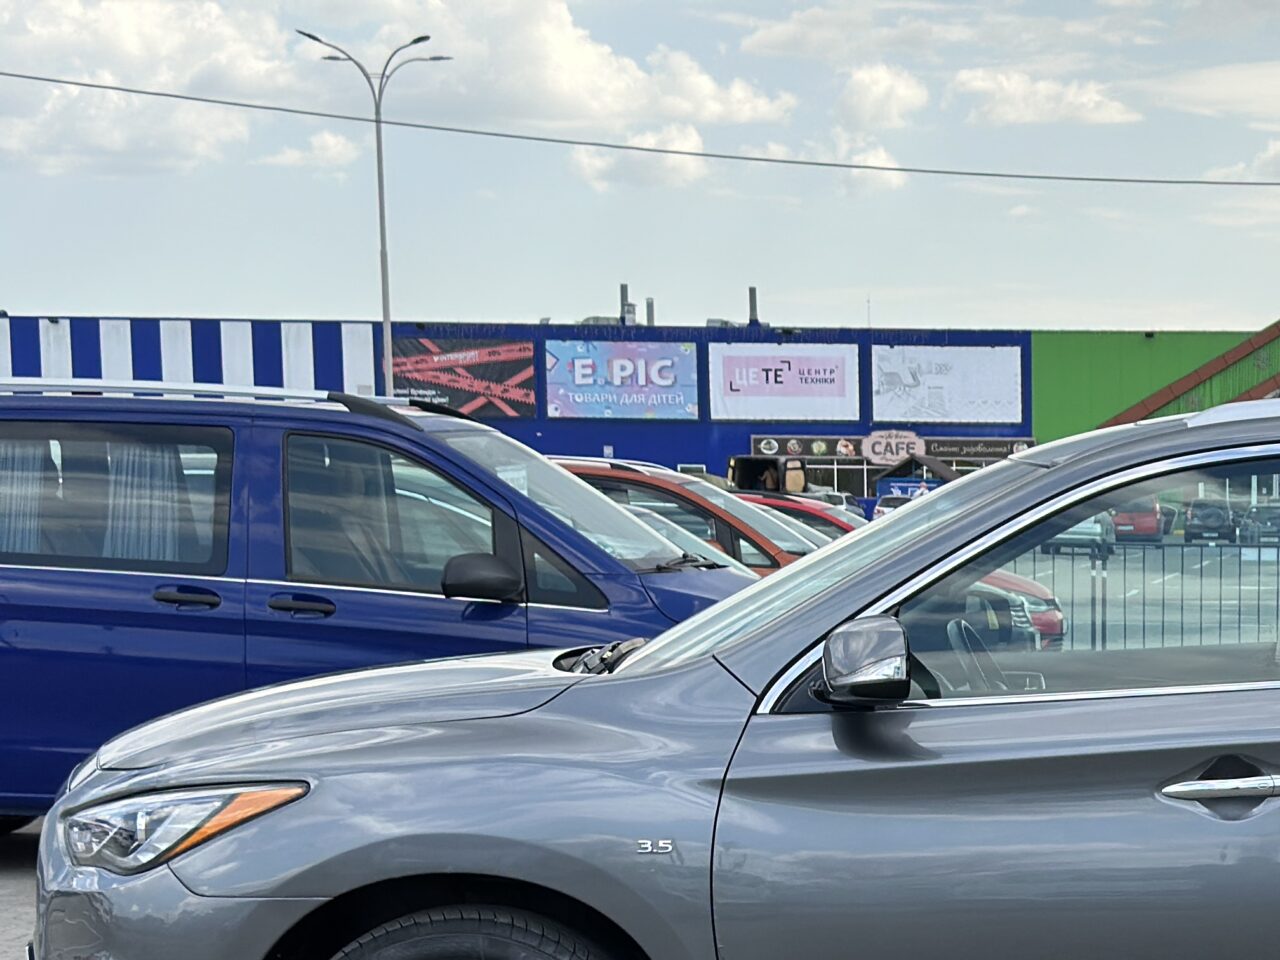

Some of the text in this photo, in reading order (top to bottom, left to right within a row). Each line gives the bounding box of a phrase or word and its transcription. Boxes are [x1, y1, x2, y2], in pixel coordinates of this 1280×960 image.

[799, 368, 835, 377] ЦЕНТР
[799, 377, 836, 385] ТЕХНІКИ
[568, 391, 685, 406] ТОВАРИ ДЛЯ ДІТЕЙ
[871, 441, 916, 456] CAFE
[637, 839, 673, 854] 3.5
